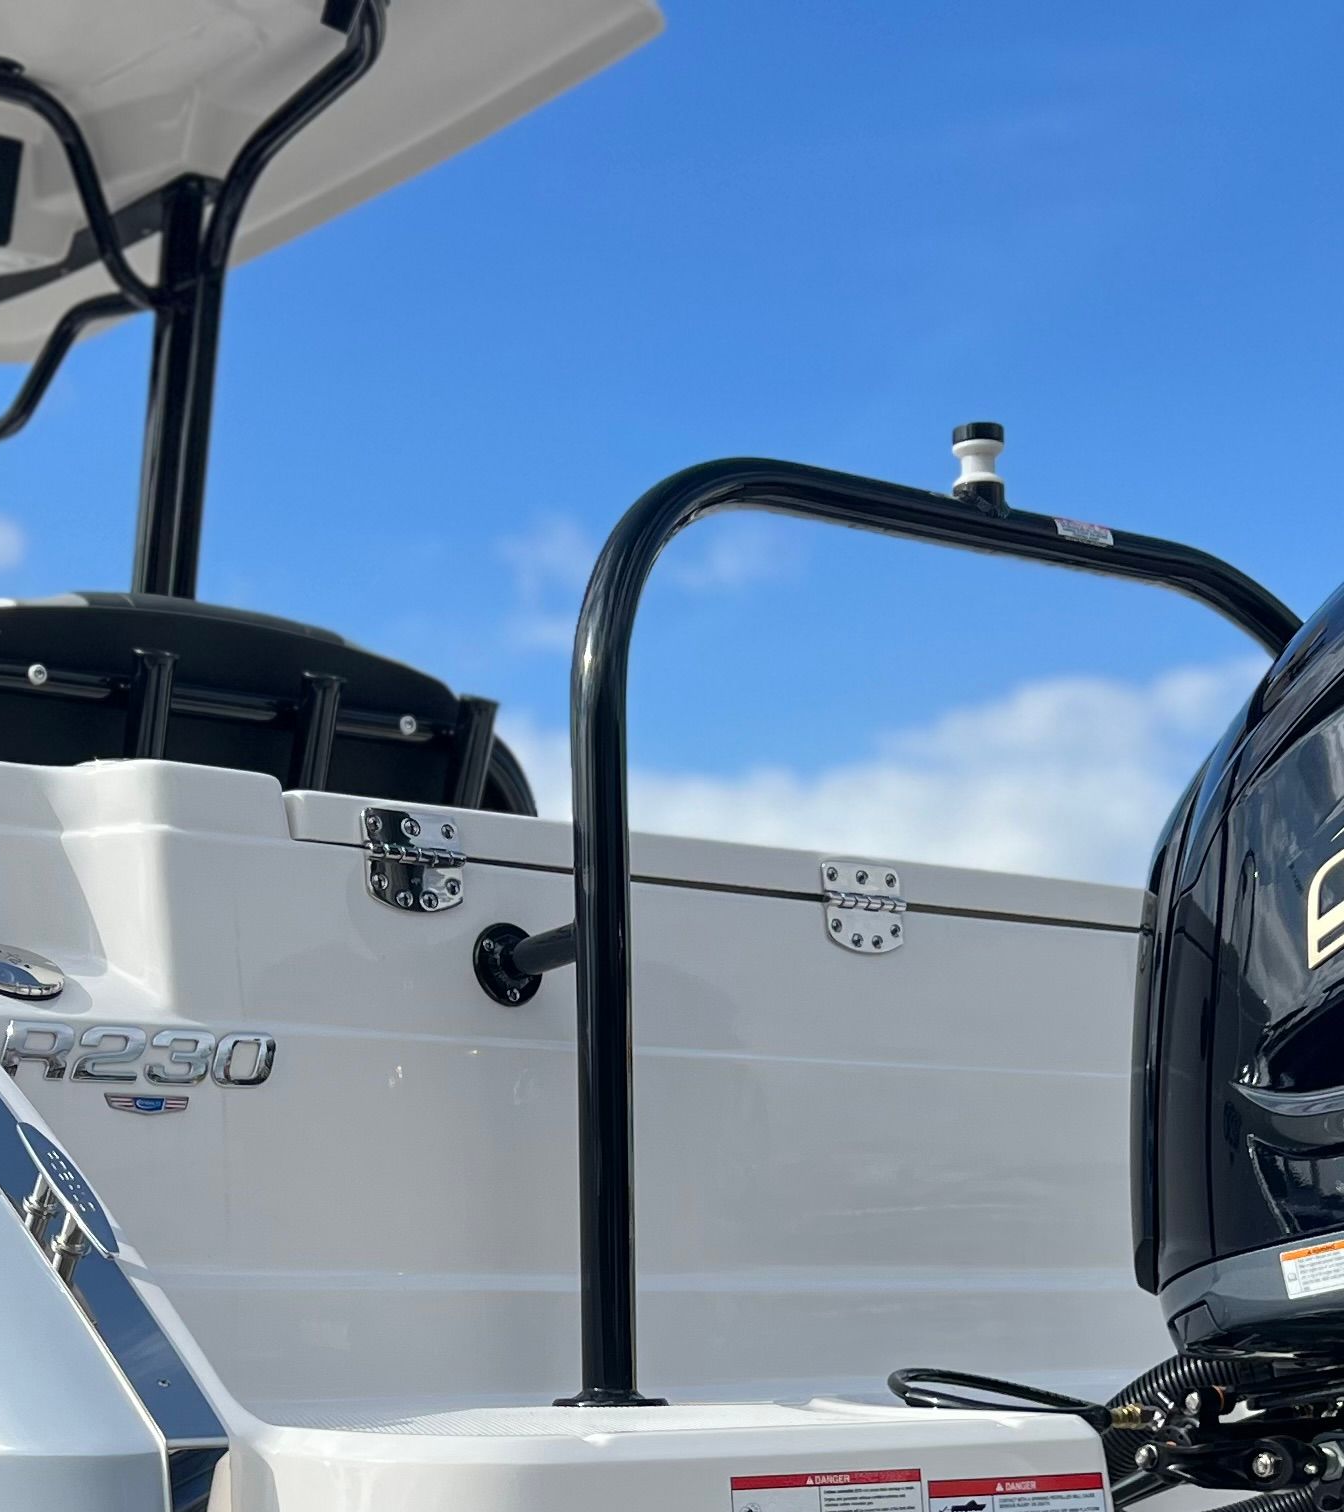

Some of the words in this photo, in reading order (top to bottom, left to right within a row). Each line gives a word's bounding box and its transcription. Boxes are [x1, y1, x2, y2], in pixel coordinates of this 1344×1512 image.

[0, 1018, 276, 1088] R230
[814, 1474, 851, 1485] DANGER
[1005, 1480, 1037, 1491] DANGER
